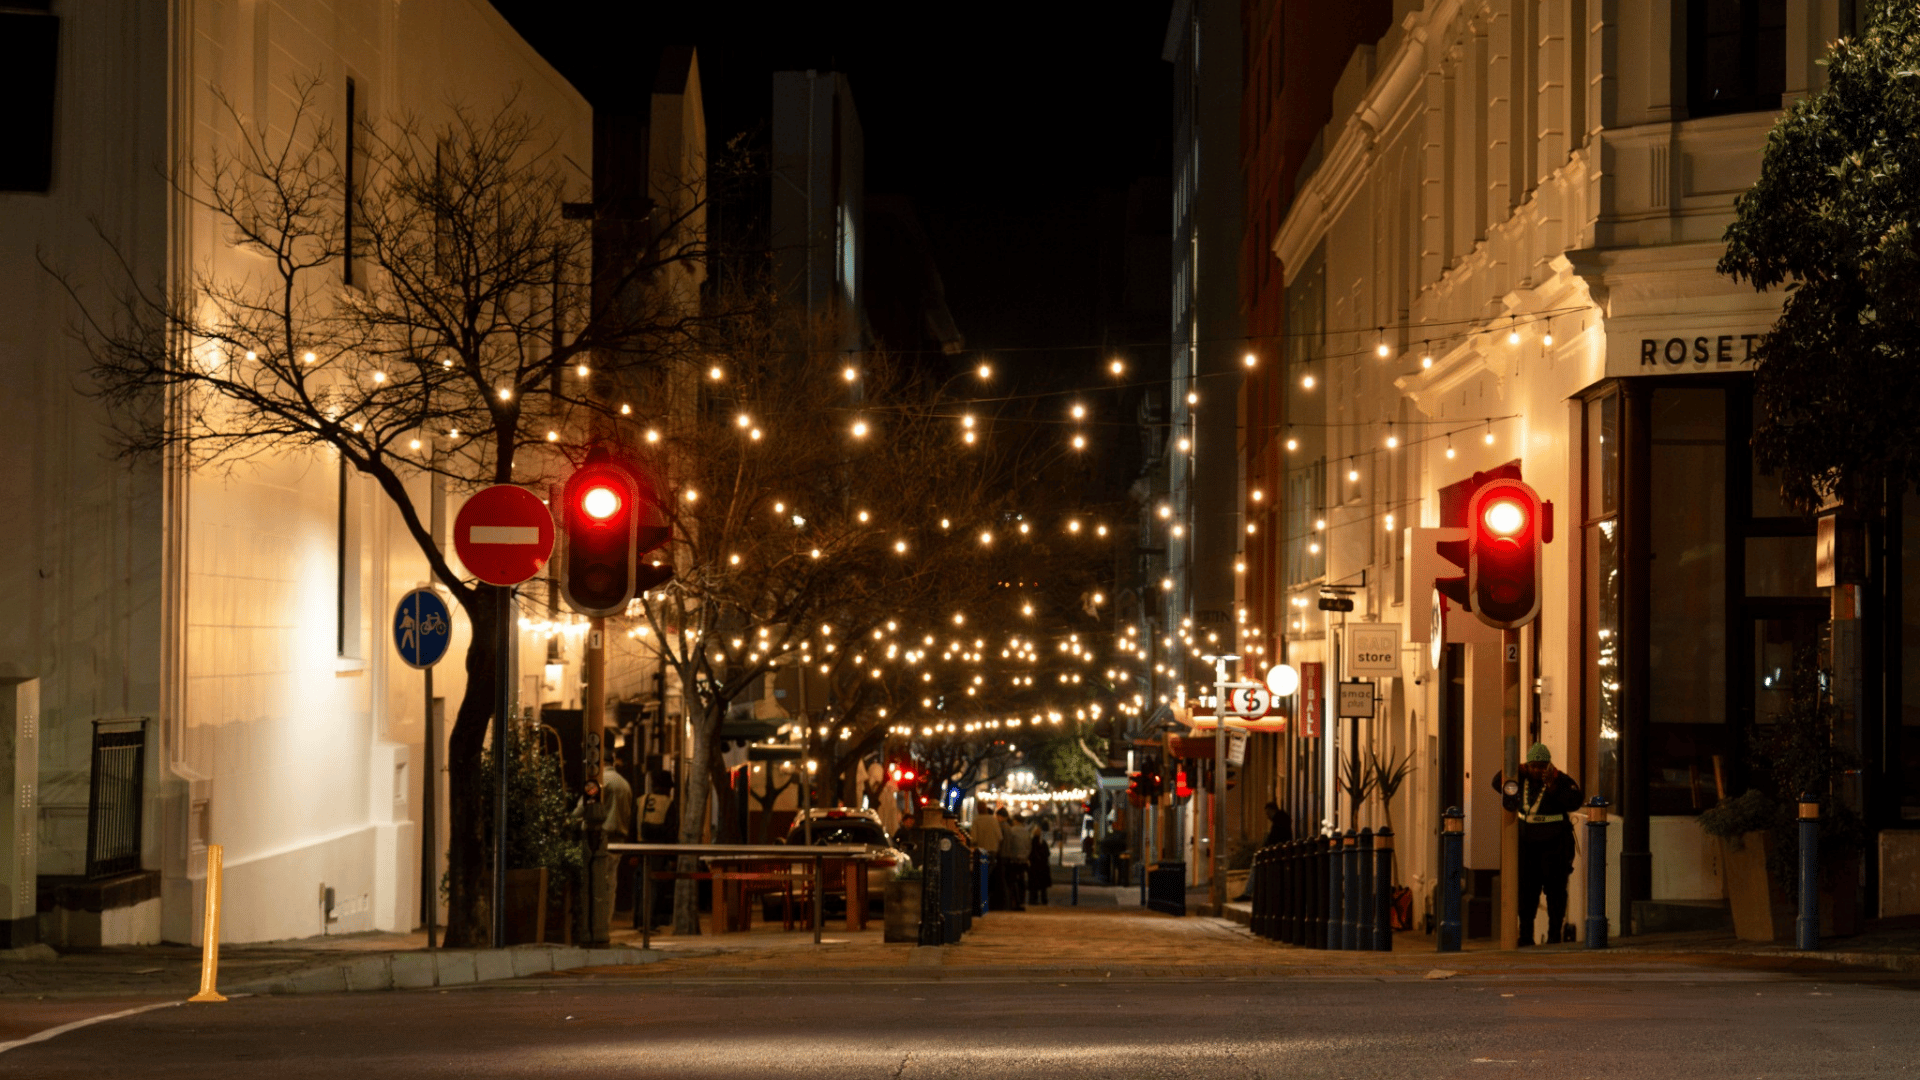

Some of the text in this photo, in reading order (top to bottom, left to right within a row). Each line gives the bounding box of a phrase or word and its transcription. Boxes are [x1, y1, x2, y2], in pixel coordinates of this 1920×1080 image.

[592, 633, 598, 646] 1
[1358, 652, 1391, 662] store
[1508, 646, 1516, 660] 2
[1341, 690, 1371, 698] smac
[1347, 700, 1364, 708] plus
